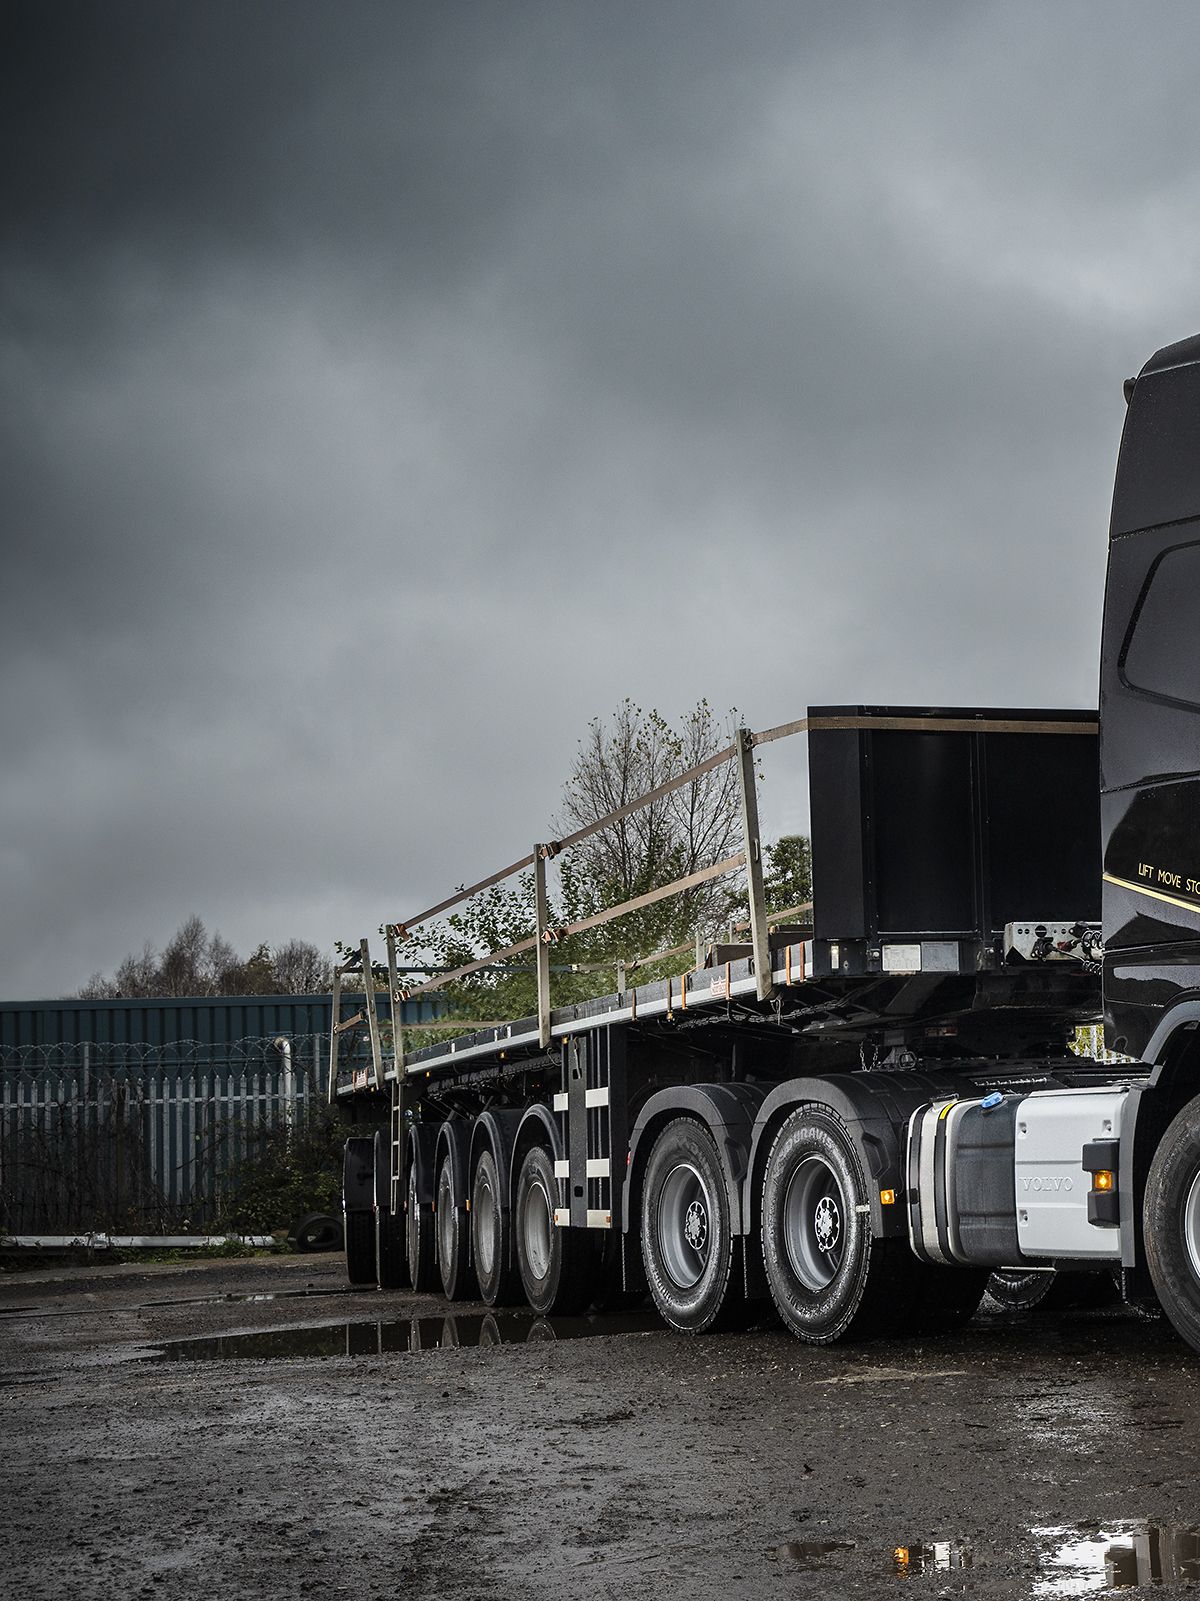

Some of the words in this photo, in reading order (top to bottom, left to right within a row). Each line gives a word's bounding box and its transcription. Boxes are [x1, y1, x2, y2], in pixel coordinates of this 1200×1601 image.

[1138, 862, 1154, 879] LIFT
[1157, 869, 1182, 889] MOVE
[1019, 1176, 1073, 1191] VOLVO
